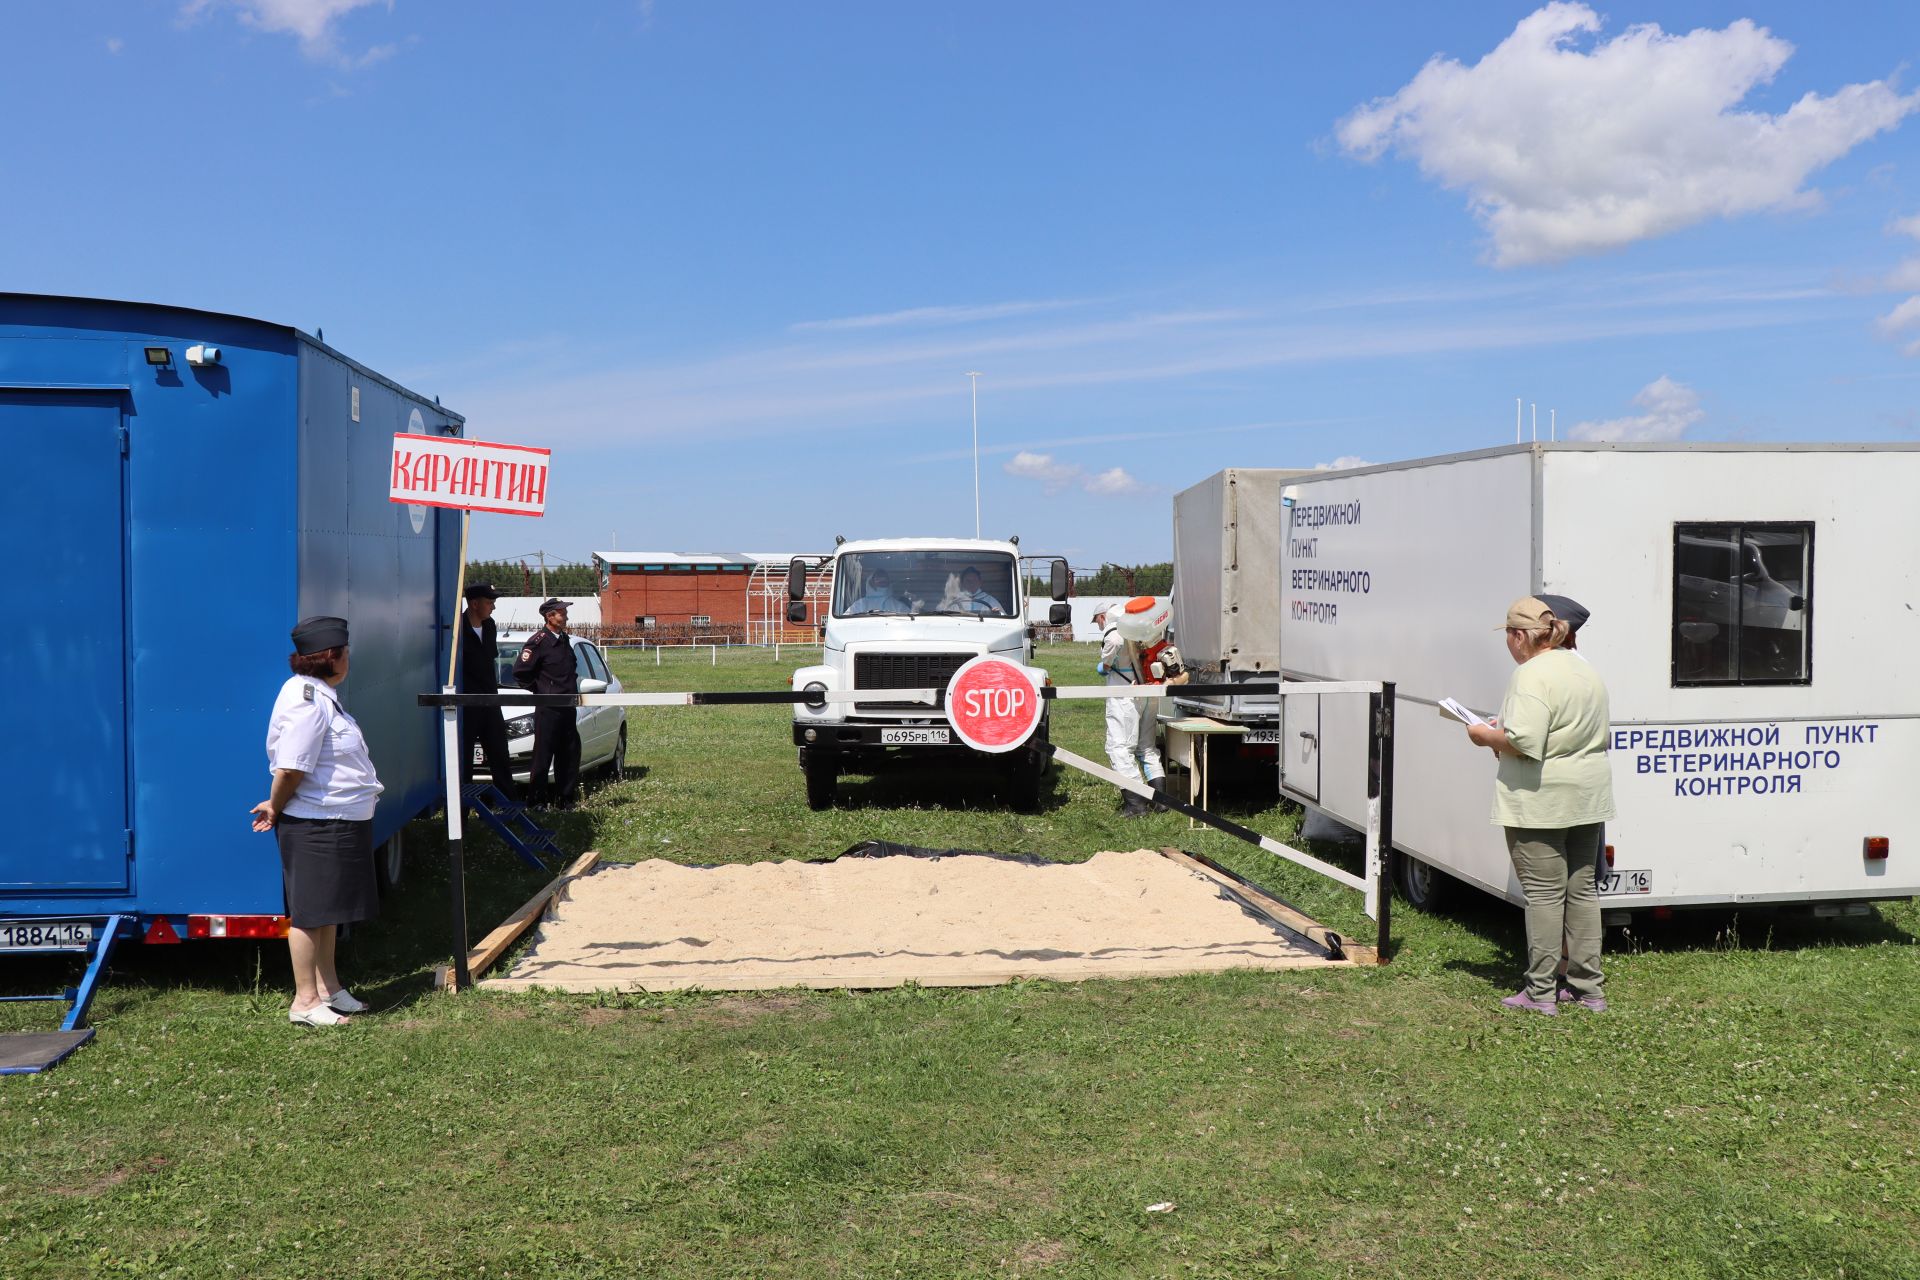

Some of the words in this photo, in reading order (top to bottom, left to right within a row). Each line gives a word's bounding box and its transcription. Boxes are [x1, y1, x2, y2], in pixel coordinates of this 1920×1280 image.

[392, 450, 546, 504] КАРАНТИН
[1291, 499, 1361, 530] ПЕРЕДВИЖНОЙ
[1291, 538, 1318, 558] ПУНКТ
[1292, 569, 1370, 593] ВЕТЕРИНАРНОГО
[1291, 600, 1337, 625] КОНТРОЛЯ
[965, 688, 1025, 718] STOP
[930, 730, 944, 738] 116
[1805, 725, 1878, 744] ПУНКТ
[1636, 750, 1840, 774] ВЕТЕРИНАРНОГО
[1675, 775, 1801, 796] КОНТРОЛЯ
[1595, 874, 1621, 892] 37
[1630, 872, 1647, 886] 16
[3, 926, 58, 946] 1884
[63, 925, 84, 940] 16
